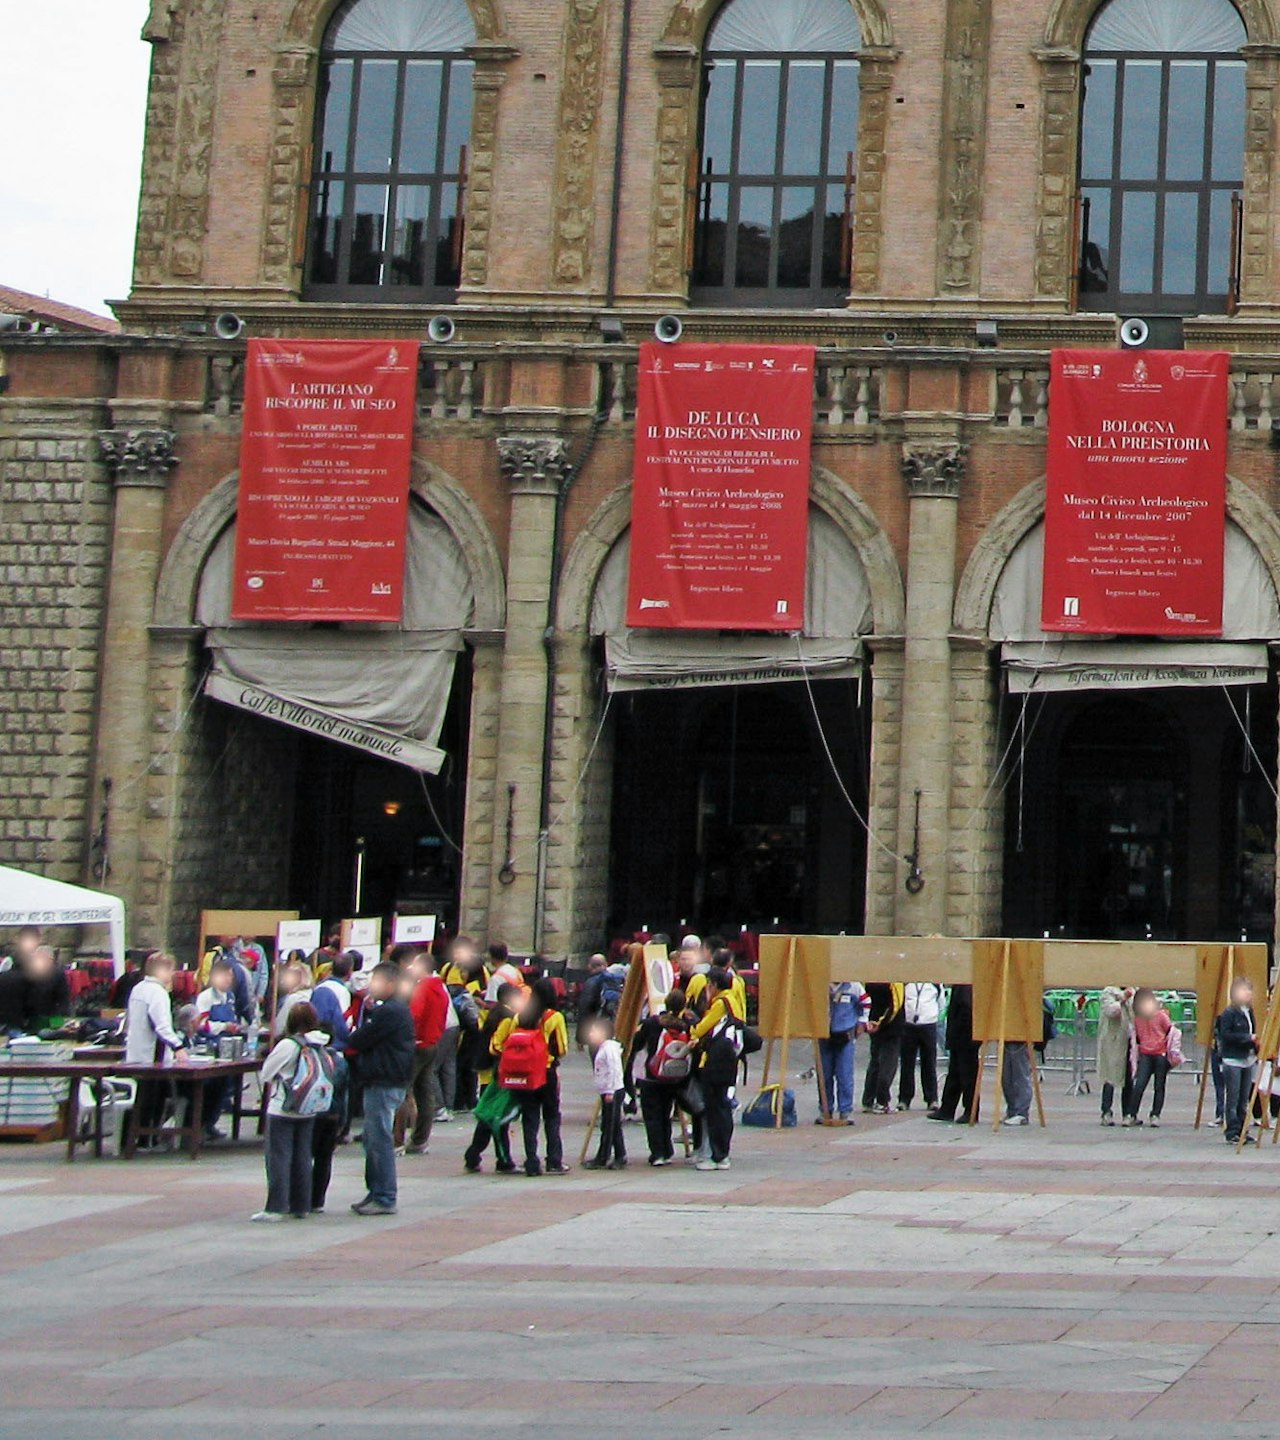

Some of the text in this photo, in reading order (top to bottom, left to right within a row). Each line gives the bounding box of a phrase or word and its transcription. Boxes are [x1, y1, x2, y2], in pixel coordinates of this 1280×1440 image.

[290, 383, 373, 395] L'ARTIGIANO
[265, 397, 396, 410] RISCOPRE IL MUSEO
[689, 412, 760, 426] DE LUCA
[647, 426, 800, 440] IL DISEGNO PENSIERO
[1102, 420, 1174, 434] BOLOGNA
[1067, 436, 1210, 450] NELLA PREISTORIA
[1088, 455, 1109, 463] una
[1149, 453, 1188, 464] sezione
[658, 488, 784, 500] Museo Civico Archeologico
[1064, 494, 1208, 508] Museo Civico Archeologico
[1078, 511, 1192, 521] dal 14 dicembre 2007
[248, 538, 268, 546] Museo
